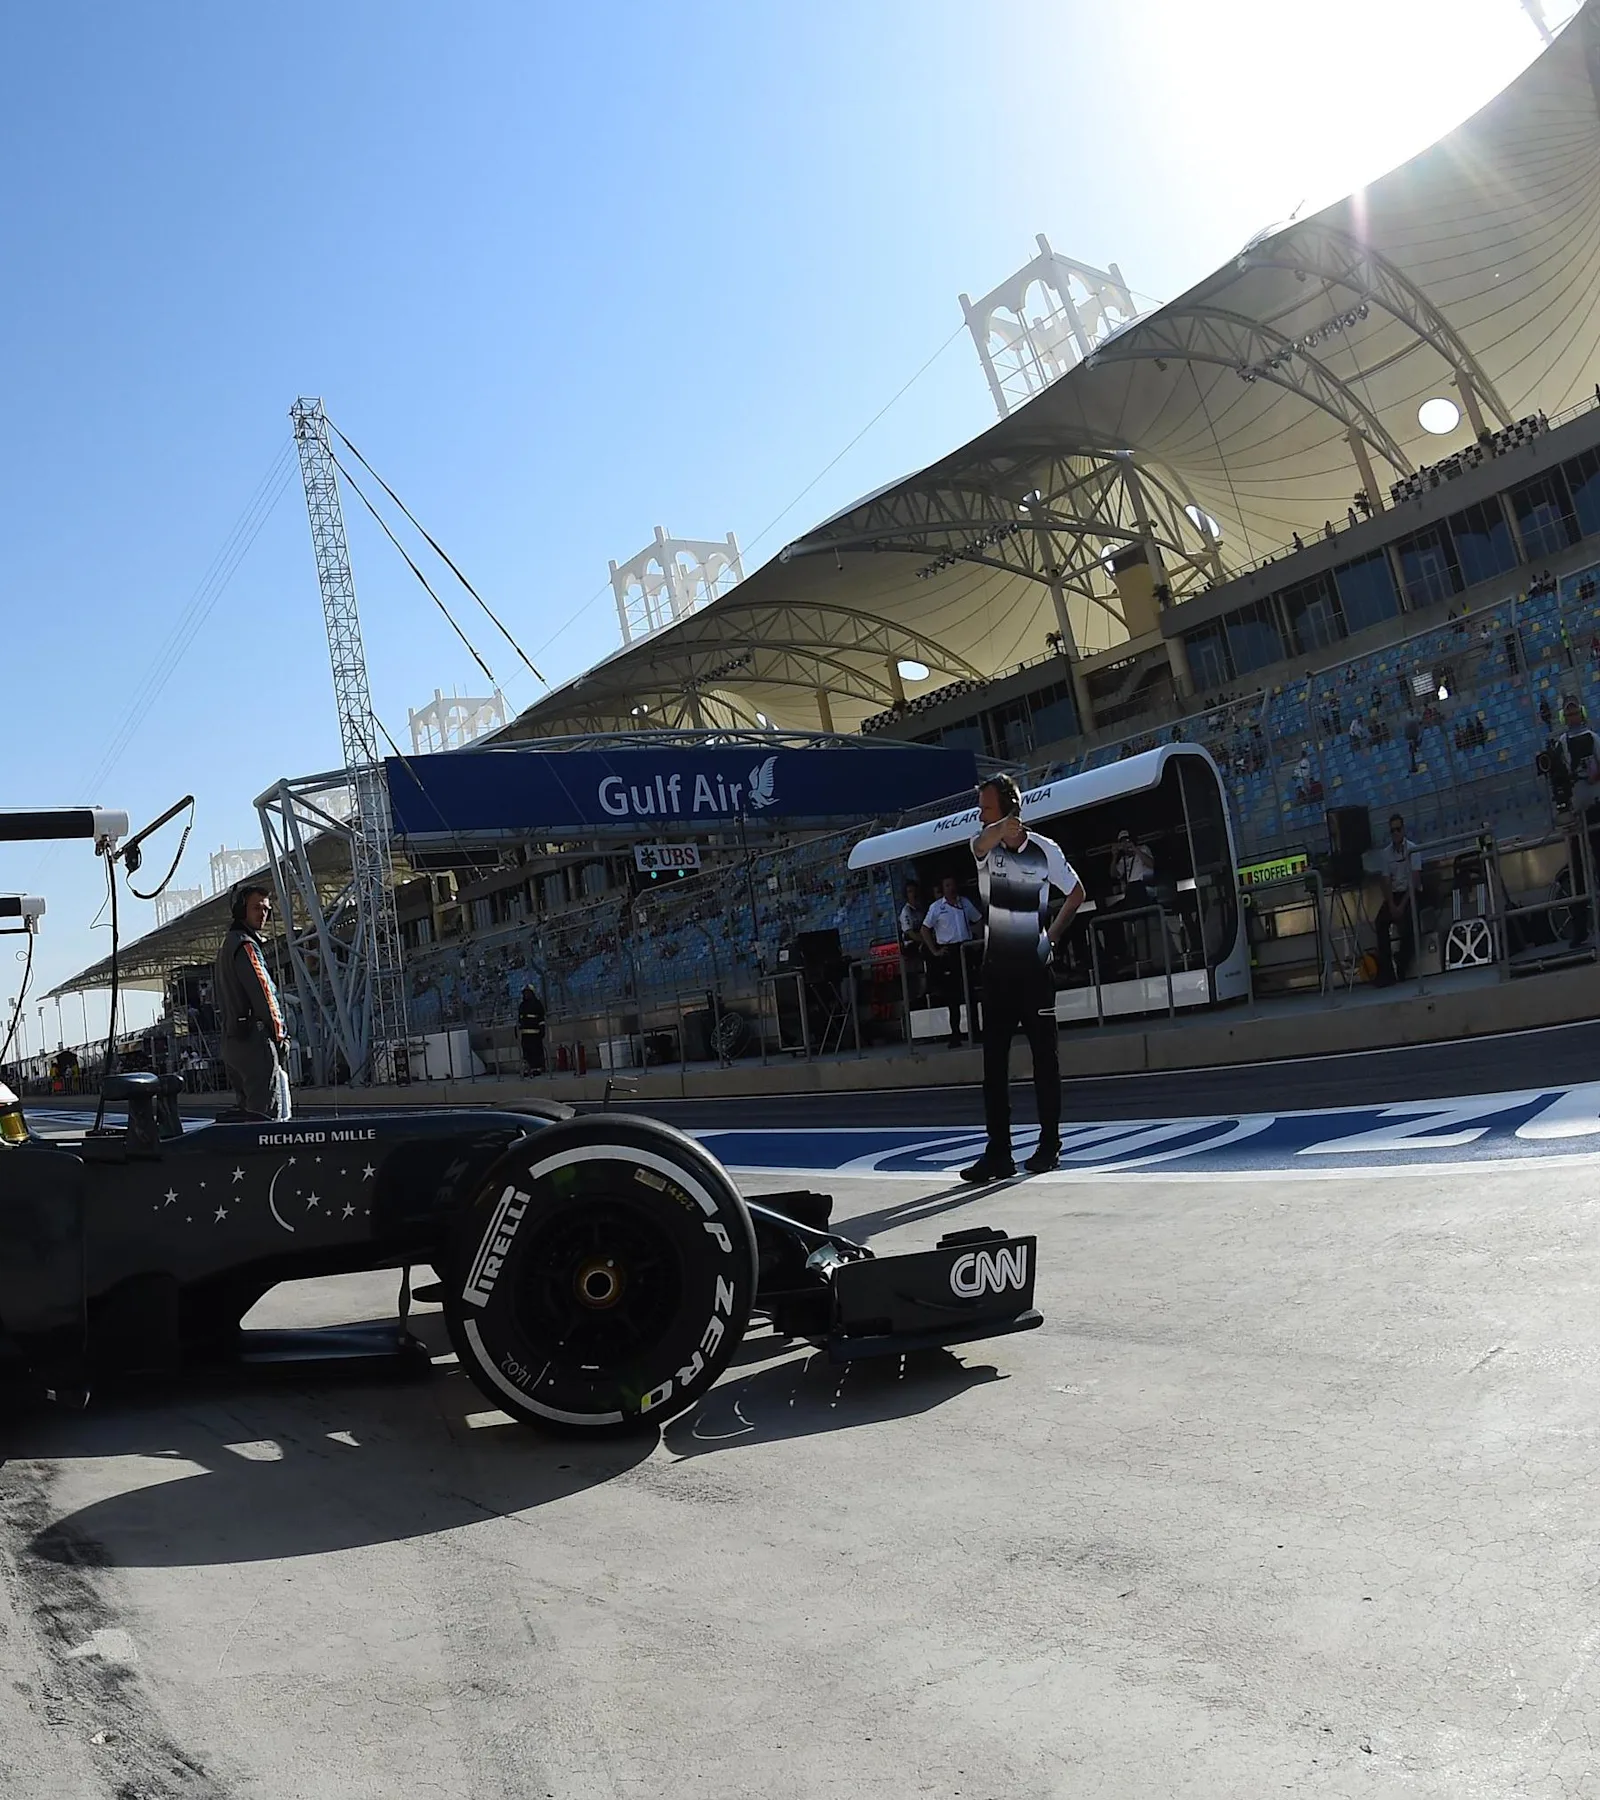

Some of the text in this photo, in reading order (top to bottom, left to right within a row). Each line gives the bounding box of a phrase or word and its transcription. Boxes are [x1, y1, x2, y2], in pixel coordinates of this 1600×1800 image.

[598, 774, 743, 816] Gulf Air
[658, 848, 695, 866] UBS
[1253, 865, 1291, 884] STOFFEL
[259, 1129, 377, 1145] RICHARD MILLE
[462, 1185, 532, 1308] PIRELLI
[950, 1245, 1027, 1298] CNN
[641, 1222, 734, 1414] P ZERO
